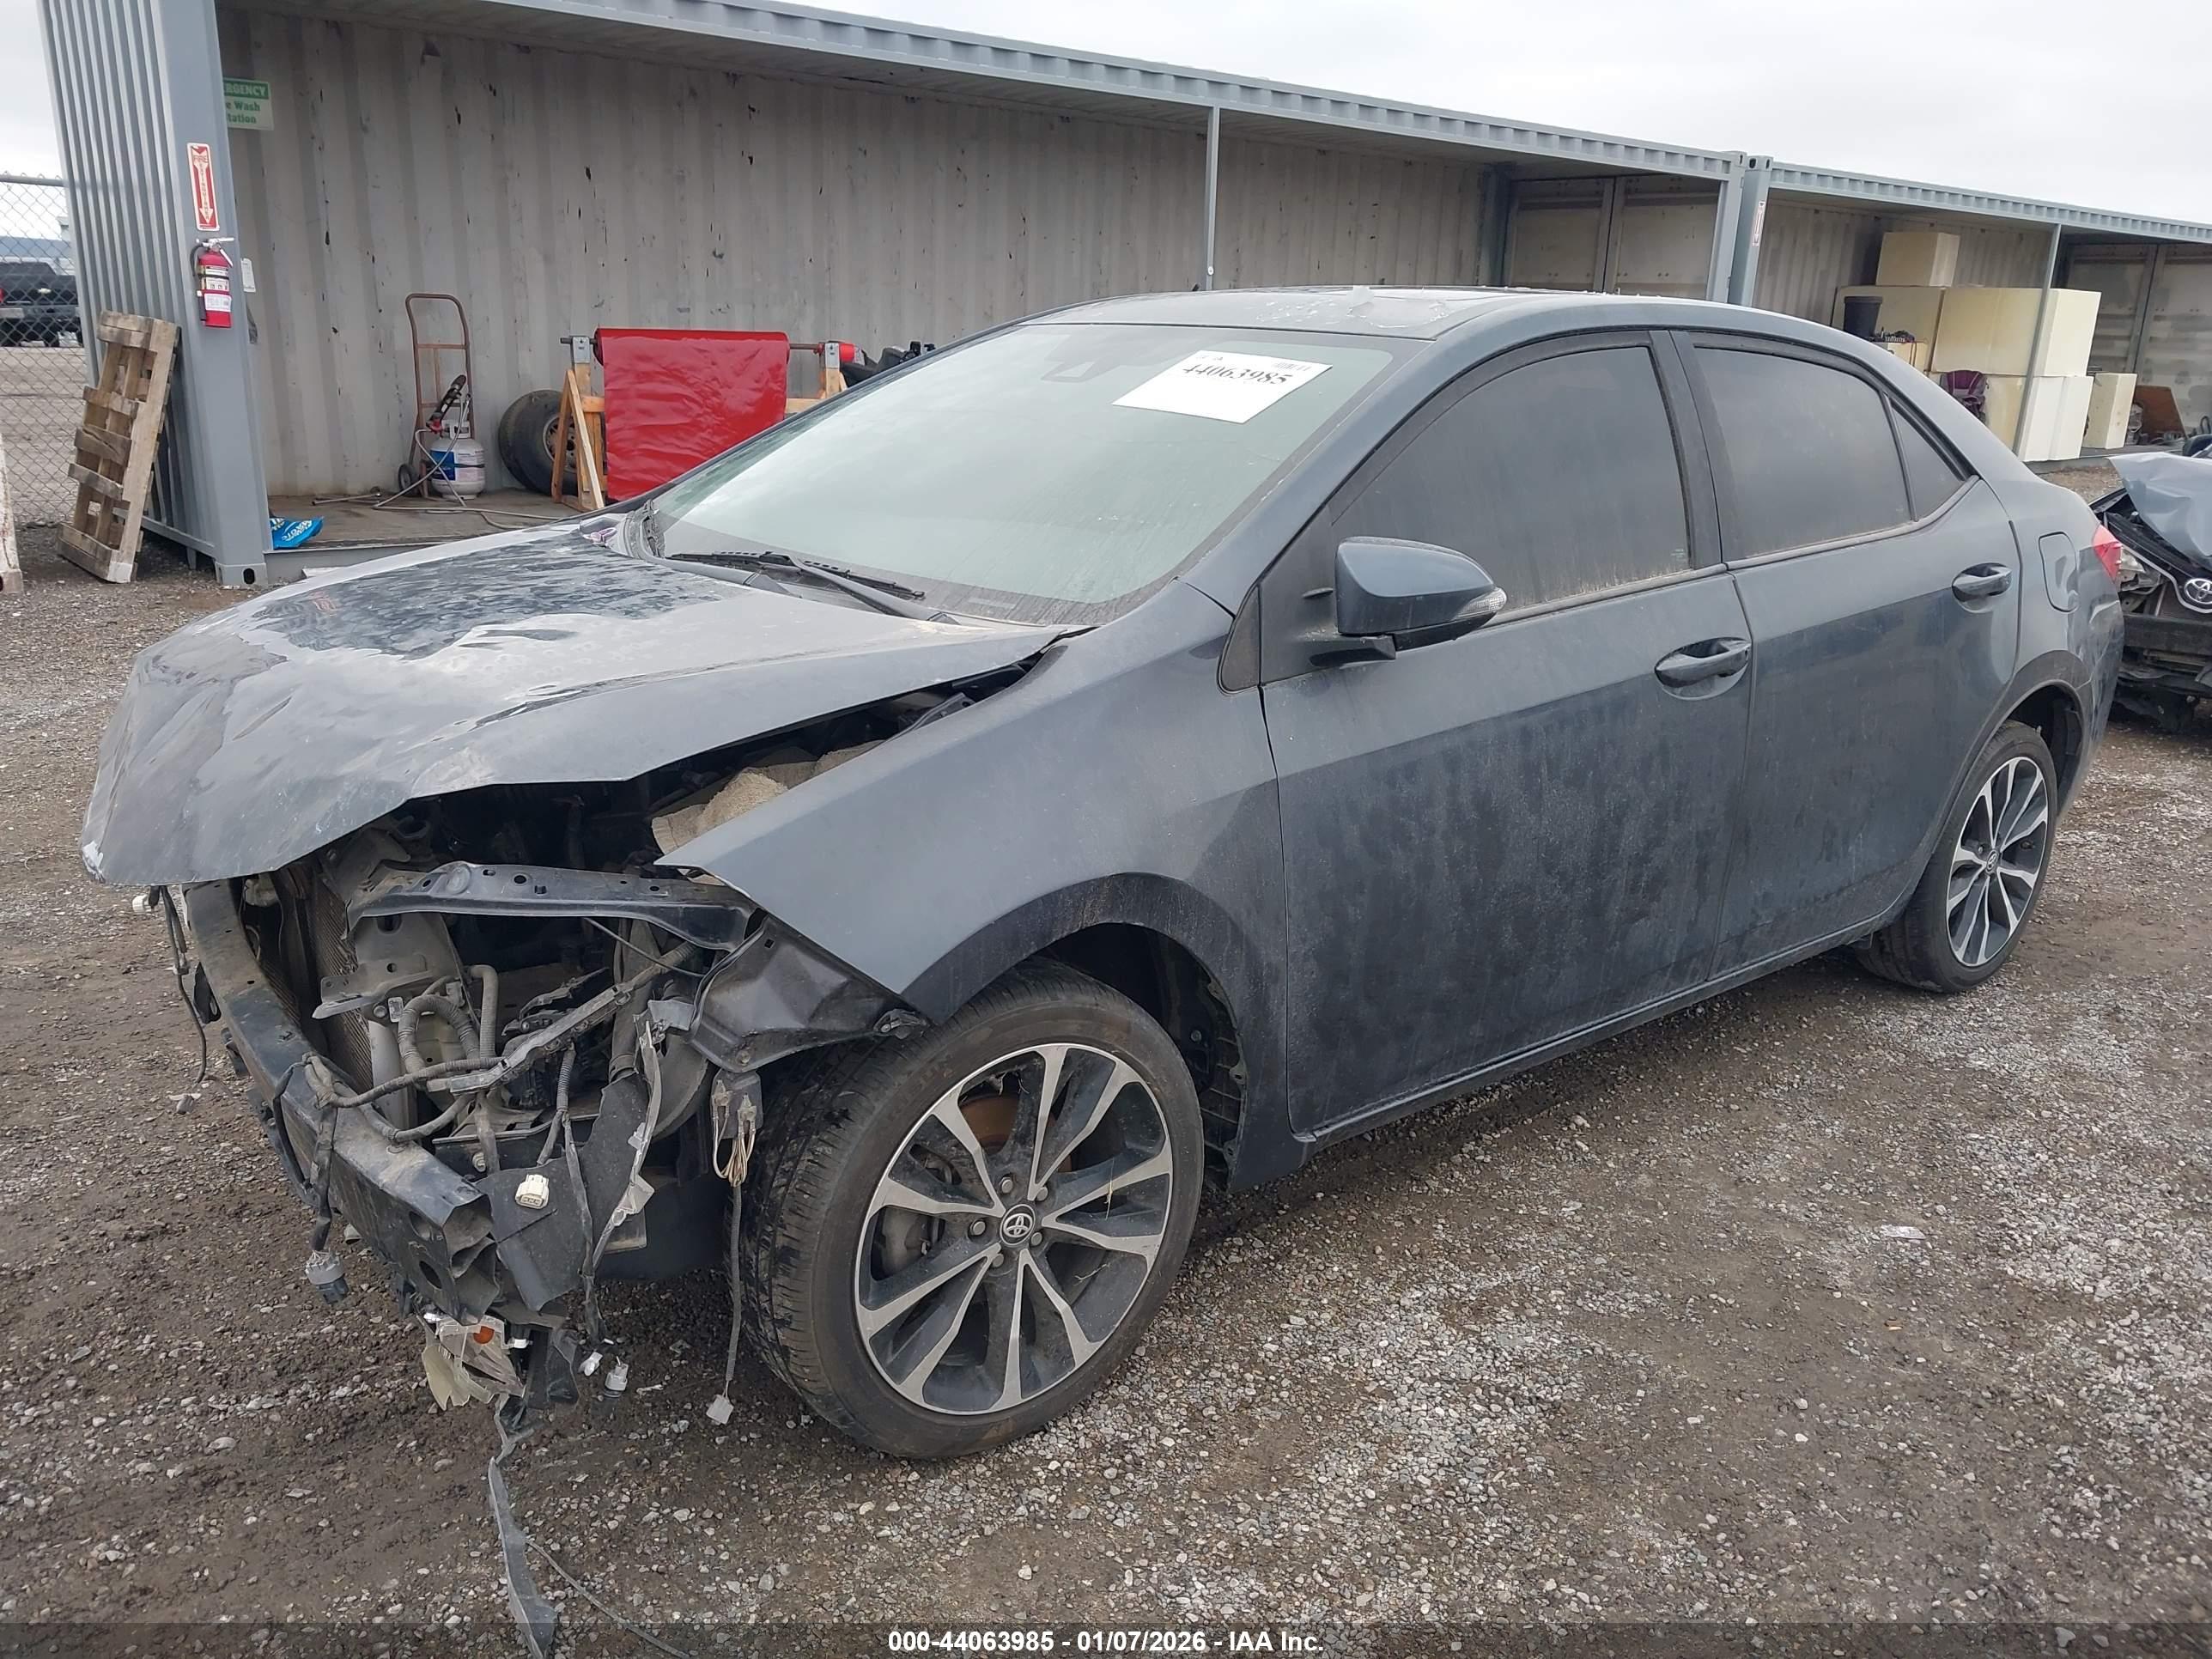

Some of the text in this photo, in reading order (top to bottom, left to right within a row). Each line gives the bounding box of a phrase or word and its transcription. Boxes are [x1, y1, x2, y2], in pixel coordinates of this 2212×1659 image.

[234, 100, 261, 112] Wash
[192, 155, 209, 163] FIRE
[1183, 363, 1293, 385] 44063985
